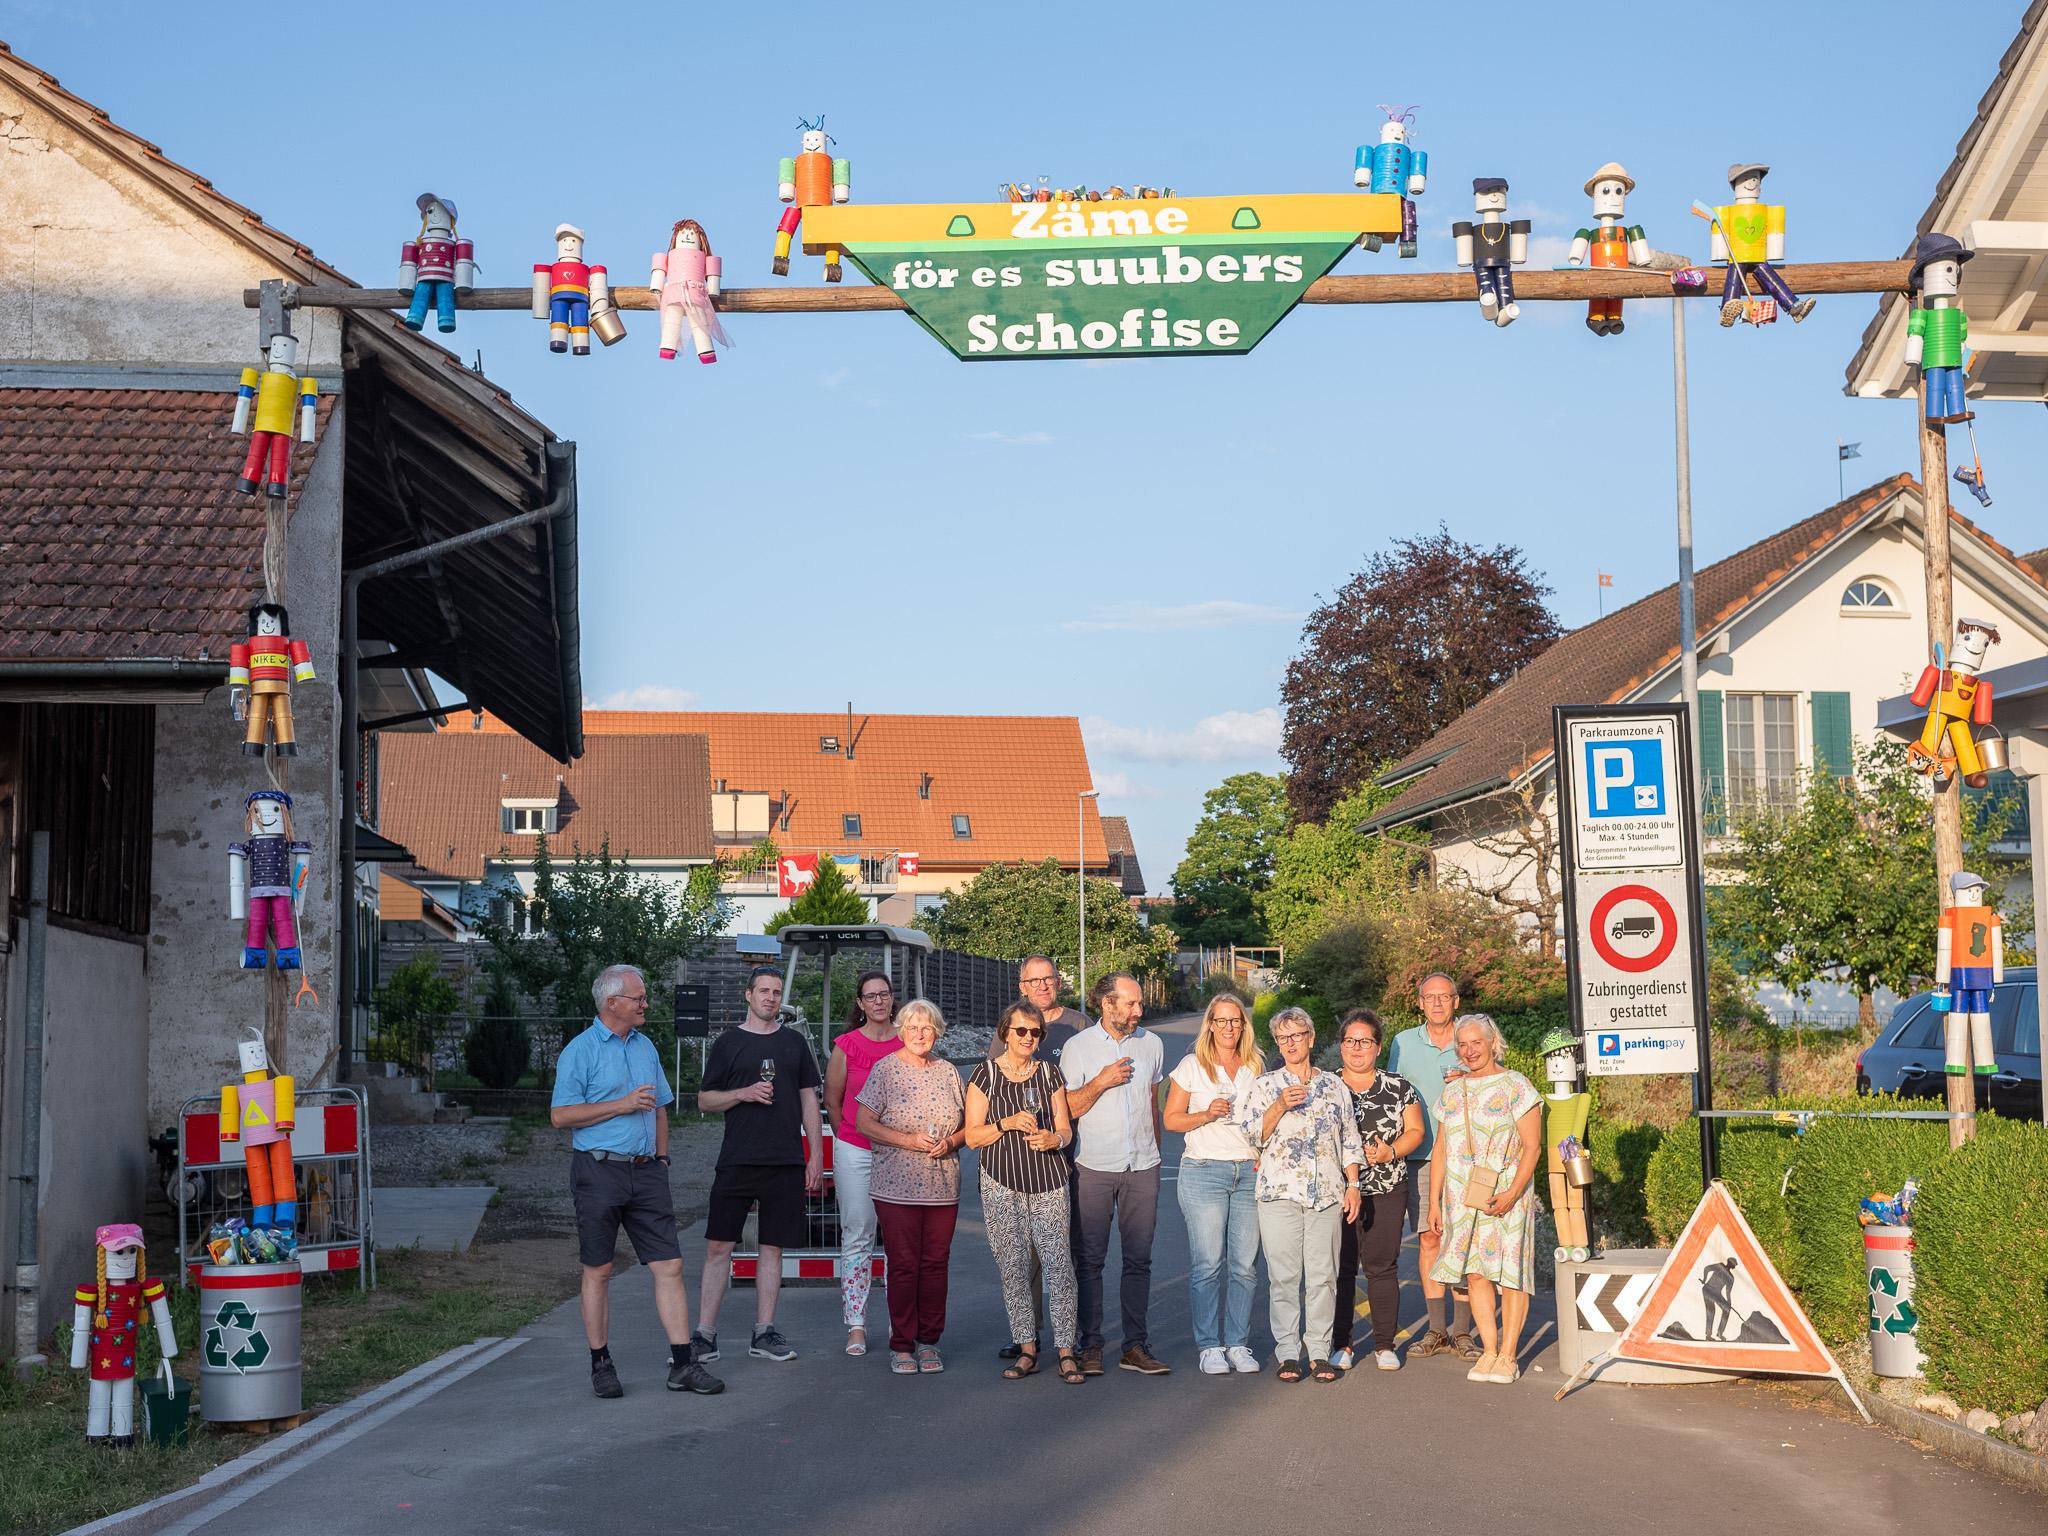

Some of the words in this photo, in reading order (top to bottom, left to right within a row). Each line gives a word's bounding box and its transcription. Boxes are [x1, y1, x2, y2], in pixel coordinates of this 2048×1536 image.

[1011, 201, 1189, 239] Zäme
[892, 260, 959, 290] för
[971, 262, 1023, 289] es
[1045, 246, 1304, 288] suubers
[967, 308, 1241, 354] Schofise
[253, 655, 276, 664] NIKE
[1580, 727, 1654, 738] Parkraumzone
[1656, 724, 1665, 735] A
[1592, 747, 1635, 811] P
[1660, 820, 1675, 829] Uhr
[1599, 834, 1618, 842] Max.
[1620, 833, 1625, 841] 4
[1627, 832, 1659, 841] Stunden
[1584, 847, 1628, 855] Ausgenommen
[1587, 980, 1687, 999] Zubringerdienst
[1610, 1004, 1667, 1022] gestattet
[1624, 1036, 1686, 1051] parkingpay
